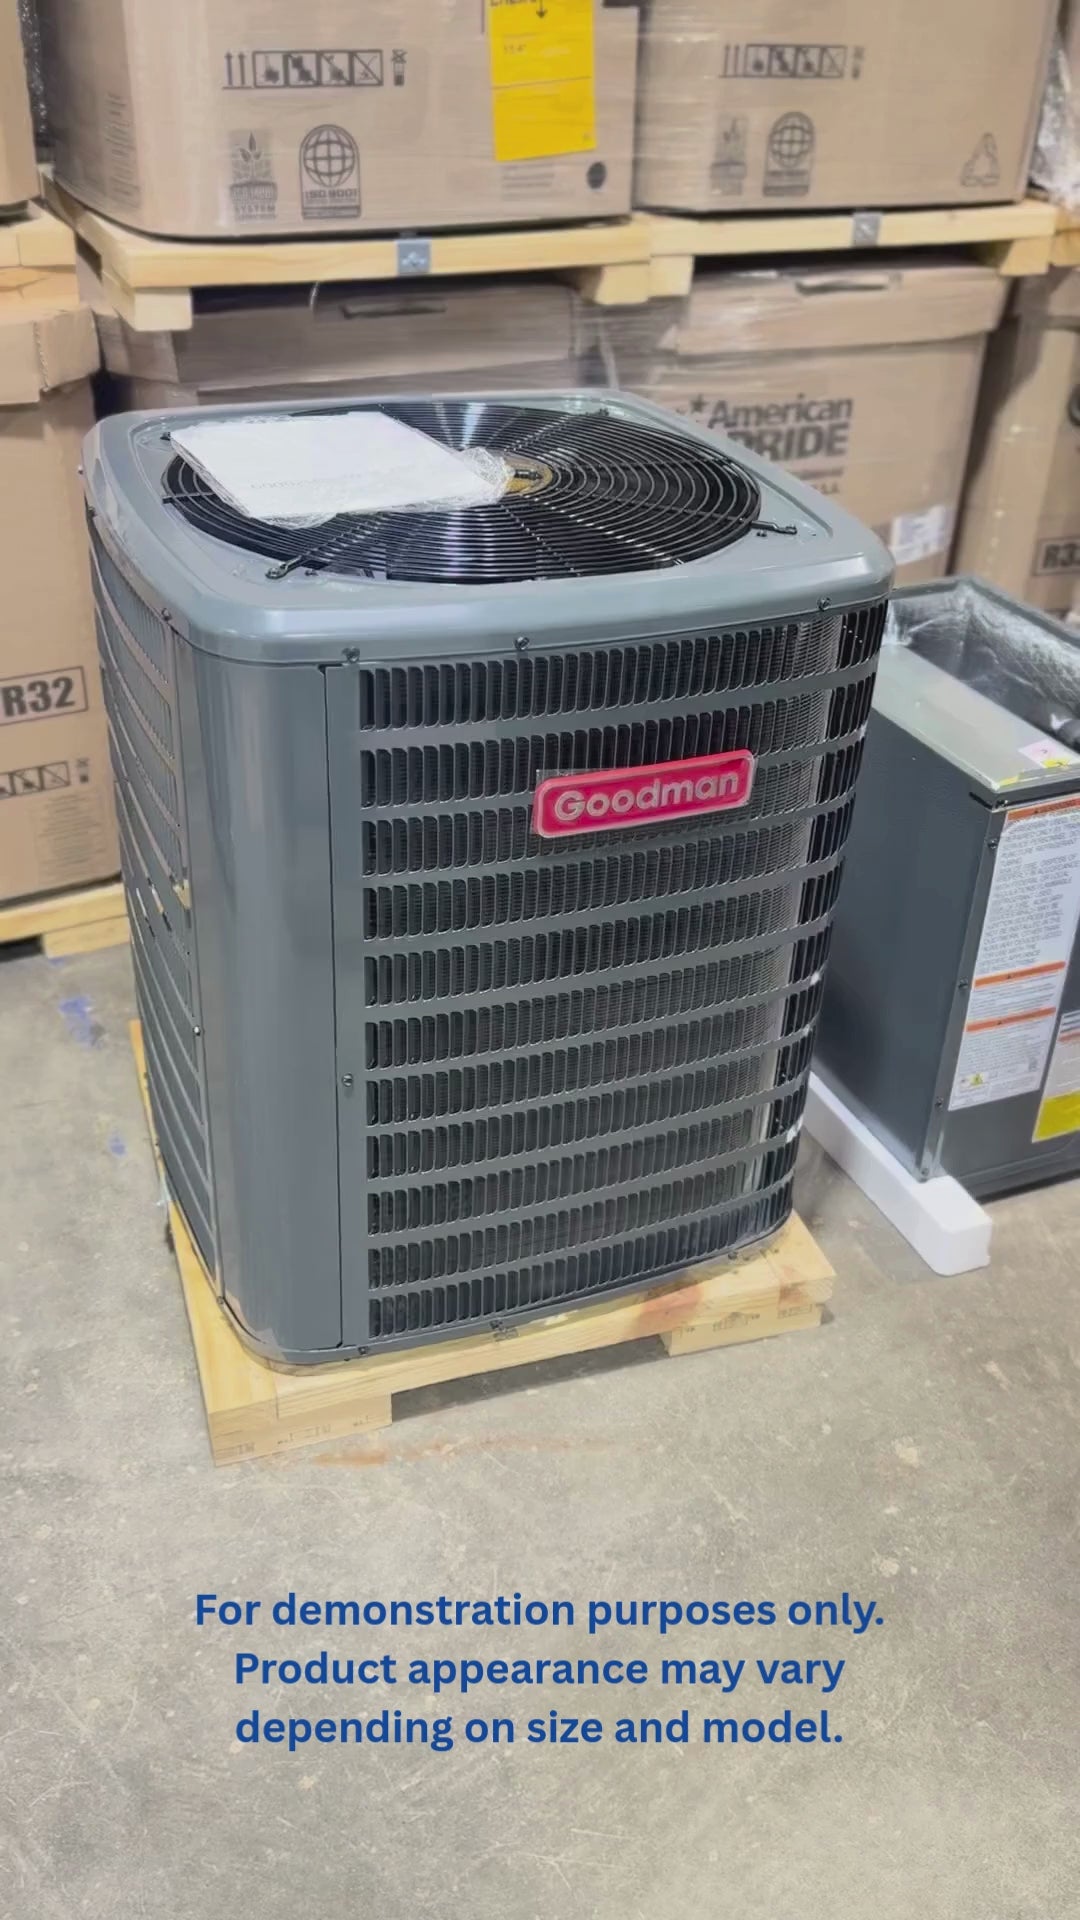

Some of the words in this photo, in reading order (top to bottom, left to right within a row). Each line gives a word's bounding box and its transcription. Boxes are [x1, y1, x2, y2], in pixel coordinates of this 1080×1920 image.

[706, 393, 853, 430] American
[1042, 543, 1080, 568] R3
[1, 676, 75, 717] R32
[554, 771, 739, 822] Goodman
